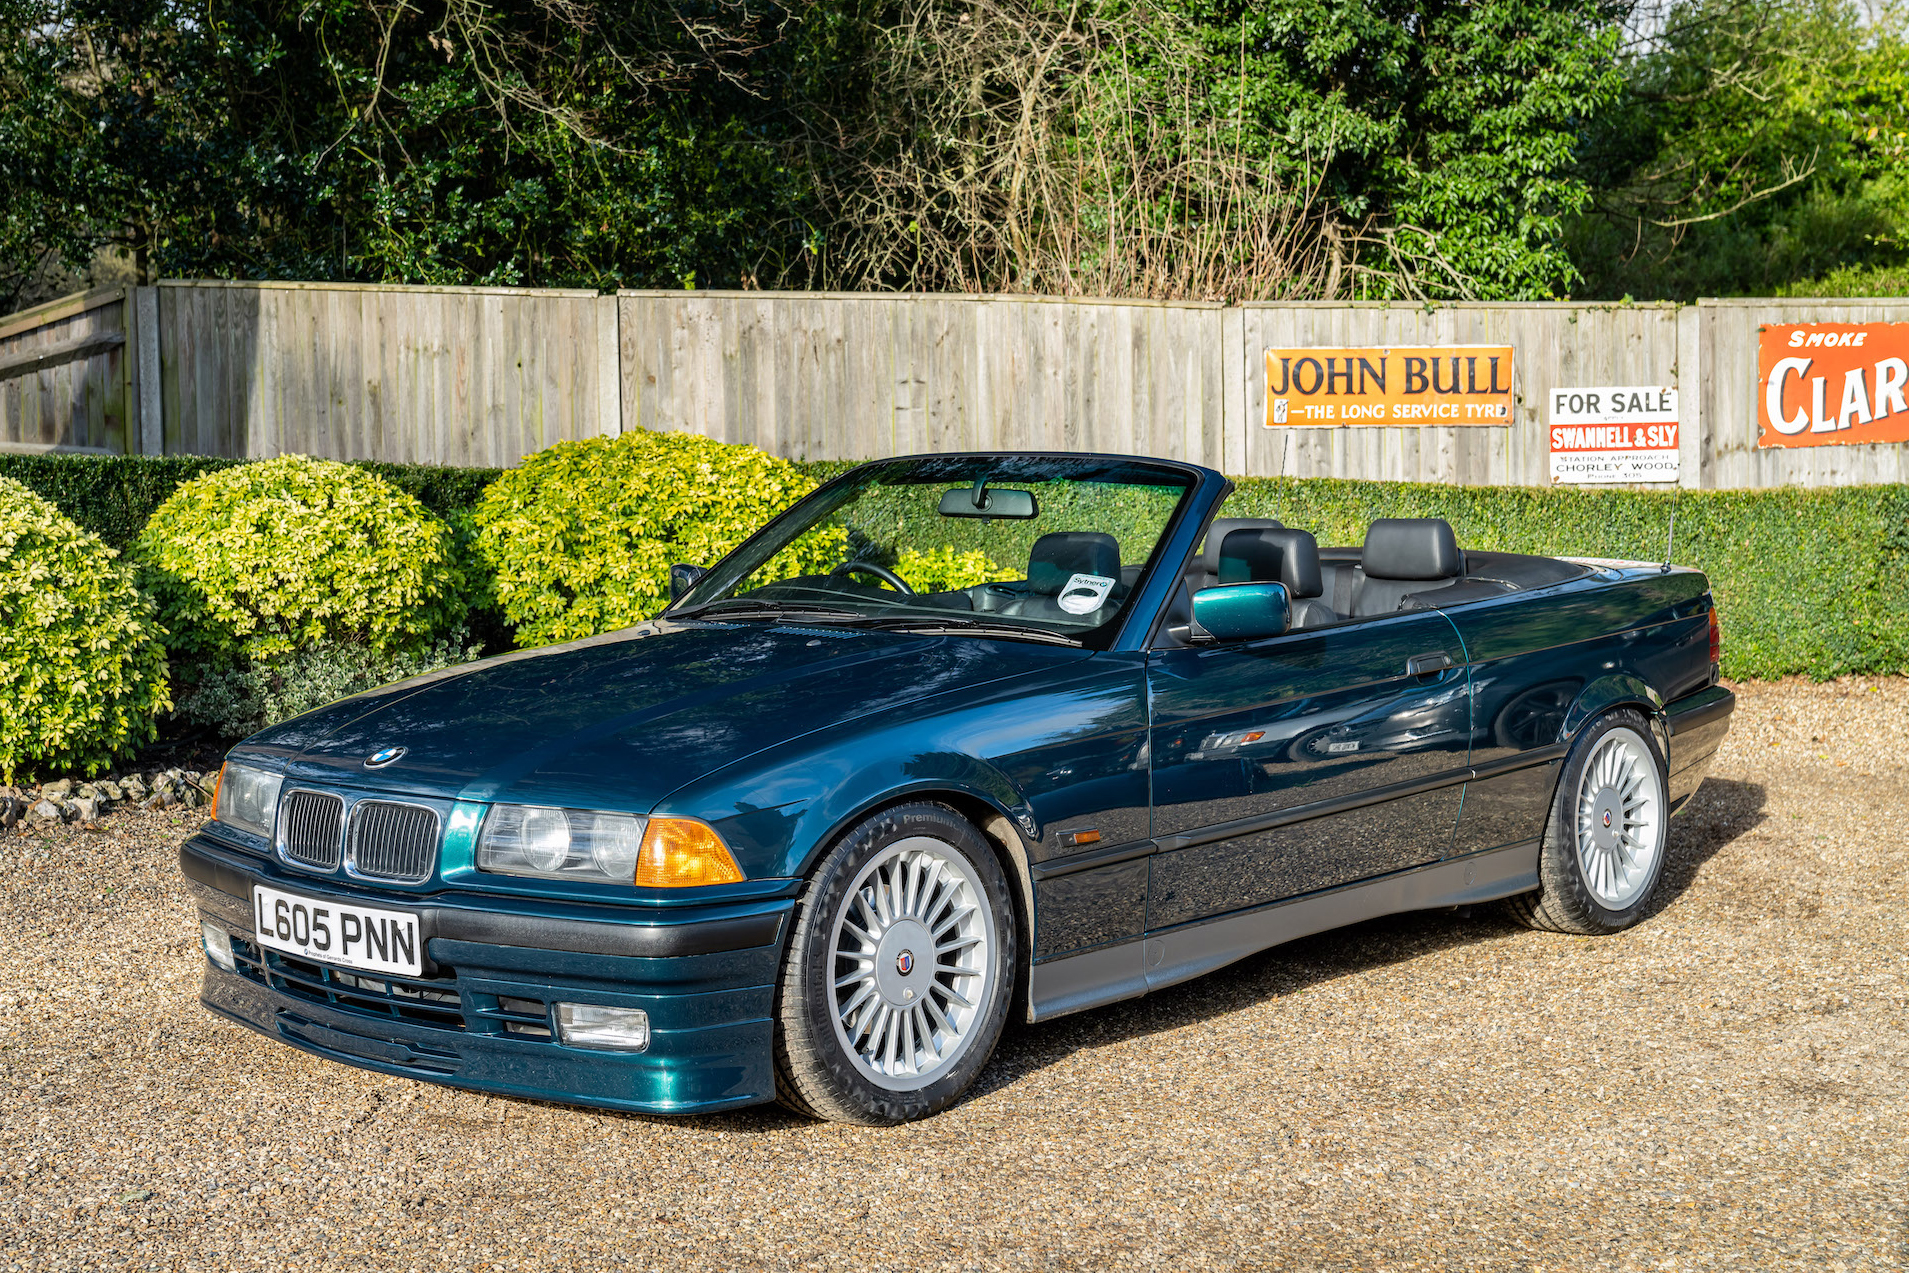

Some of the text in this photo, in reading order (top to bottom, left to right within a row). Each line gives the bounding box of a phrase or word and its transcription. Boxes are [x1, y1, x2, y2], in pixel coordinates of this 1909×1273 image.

[1788, 330, 1868, 347] SMOKE
[1271, 356, 1510, 396] JOHN BULL
[1341, 405, 1385, 419] LONG
[1392, 404, 1459, 418] SERVICE
[1465, 403, 1508, 418] TYRE
[1556, 392, 1672, 414] FOR SALE
[1610, 454, 1669, 462] APPROACH
[1556, 463, 1623, 473] CHORLEY
[1073, 577, 1100, 586] Sytner
[258, 893, 415, 965] L605 PNN
[308, 950, 322, 958] Prophets
[812, 964, 836, 1056] Continental
